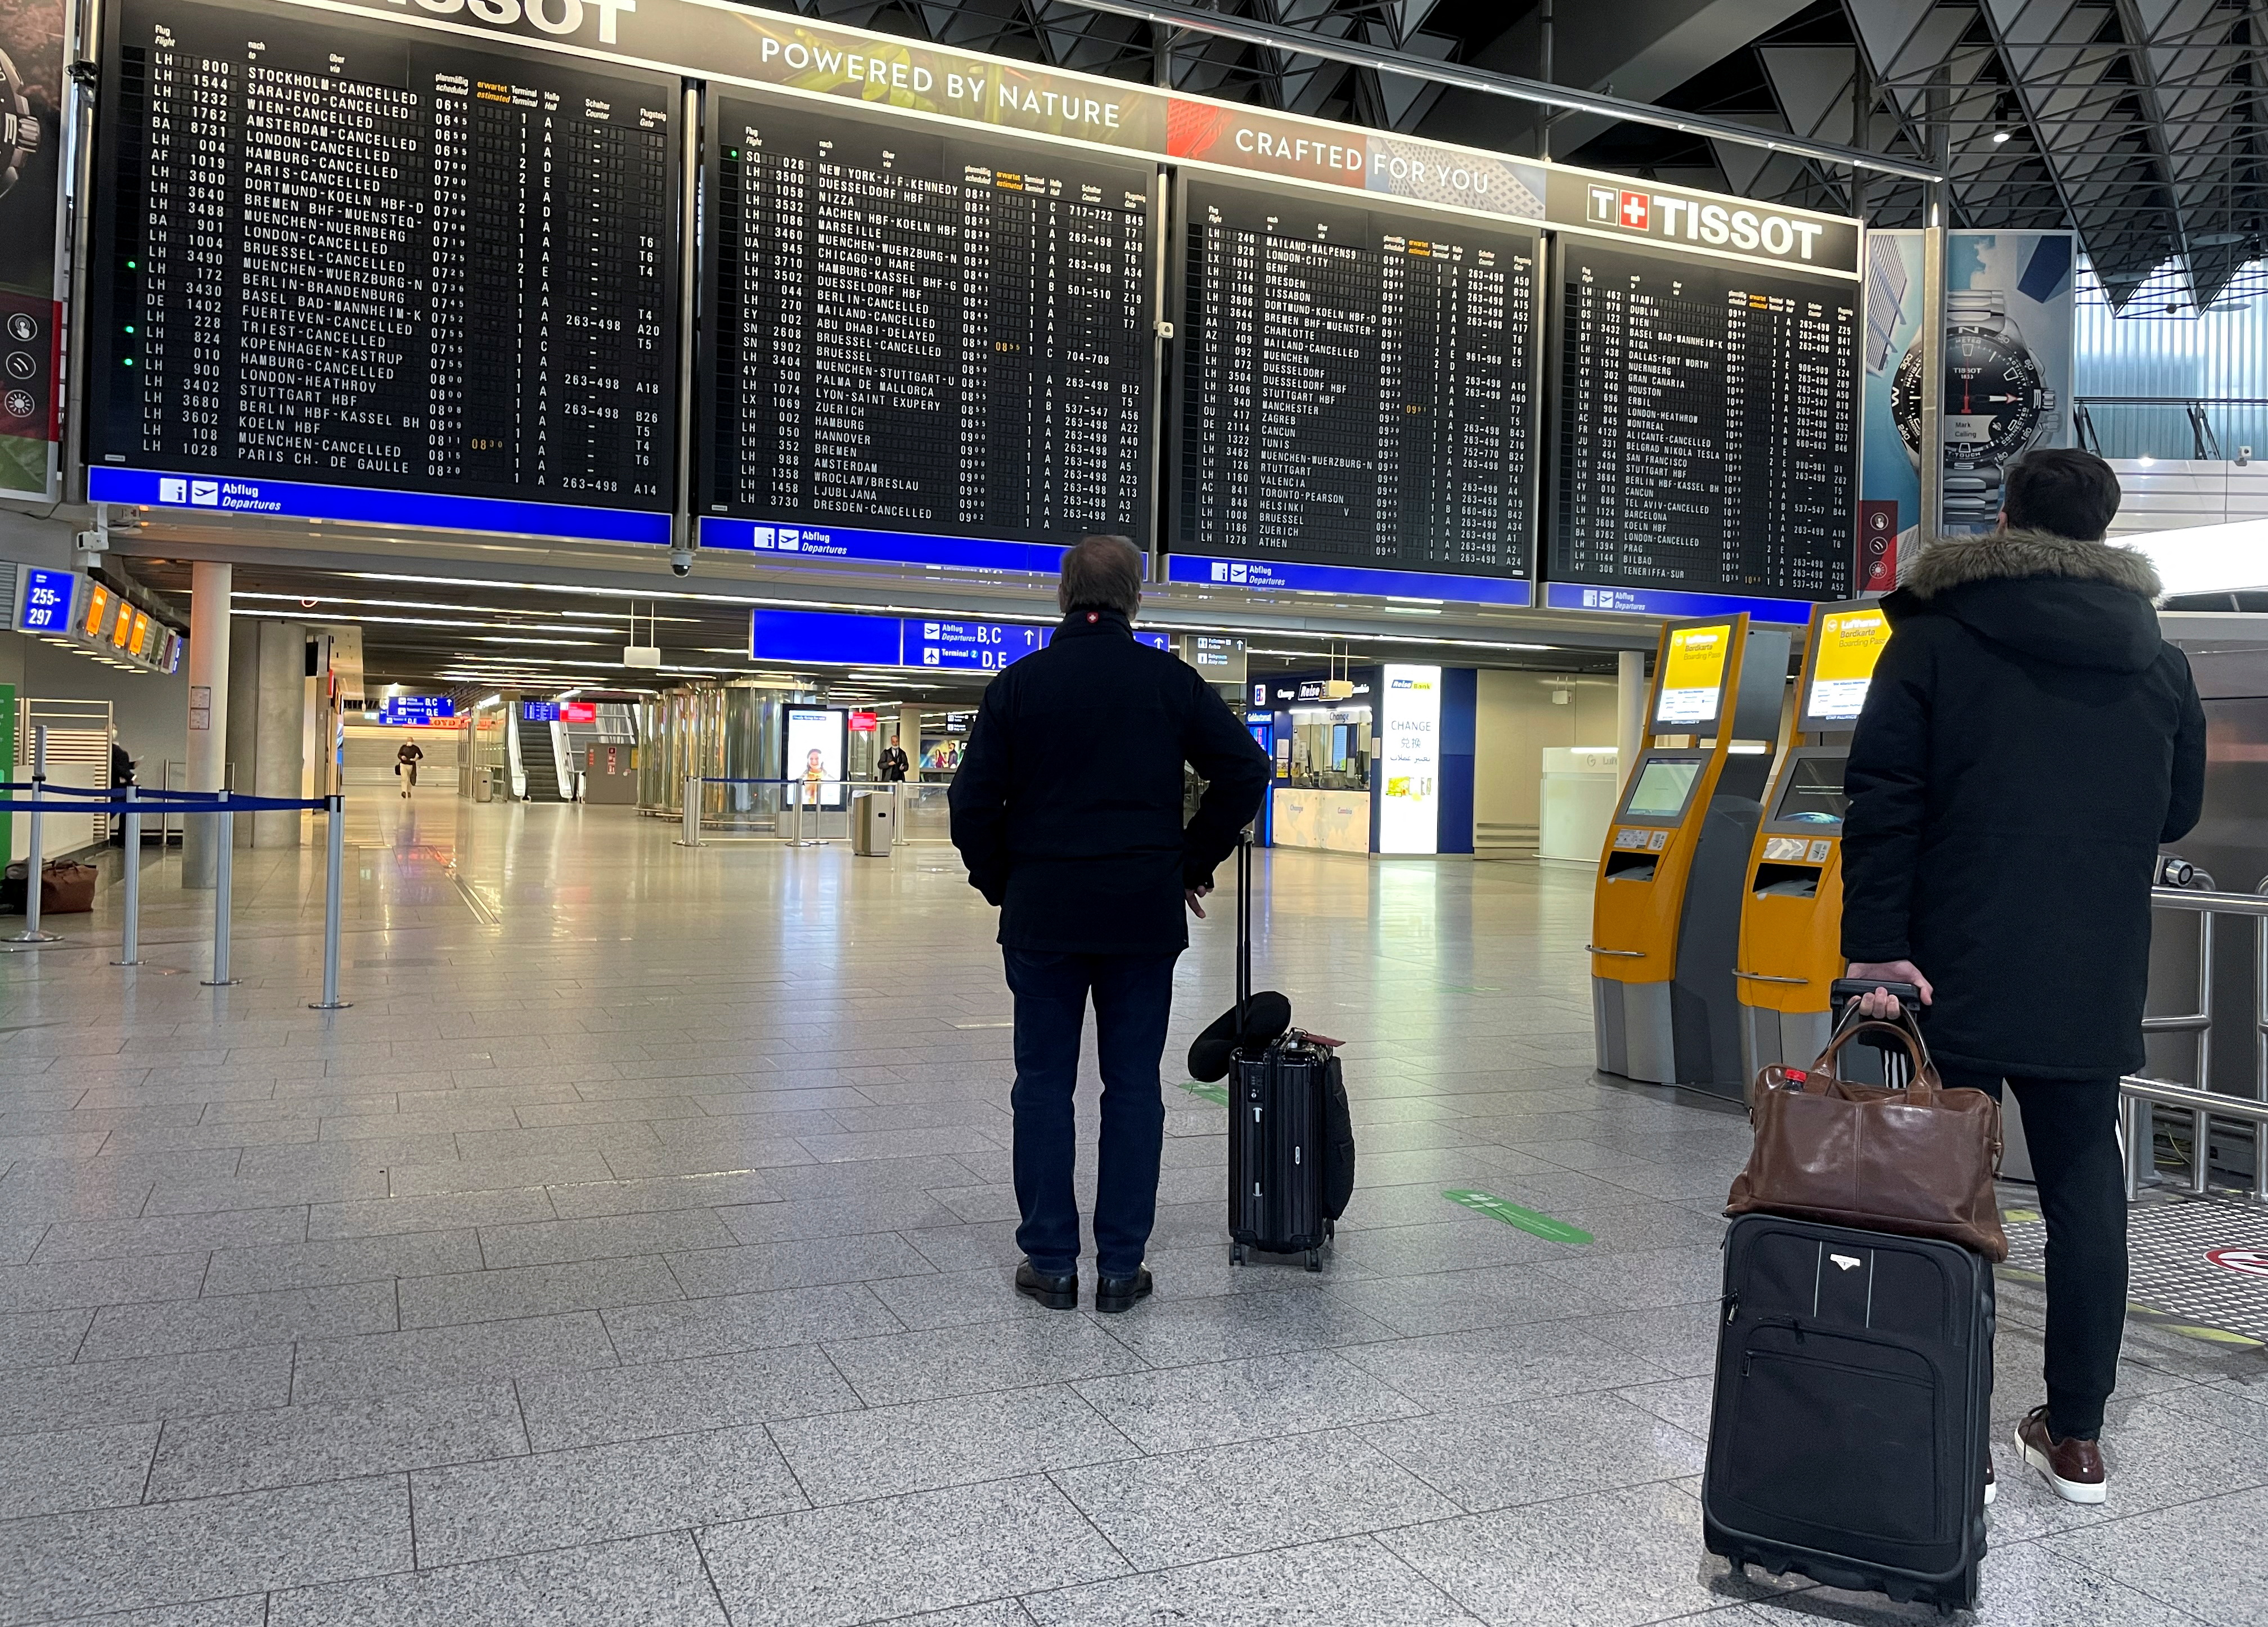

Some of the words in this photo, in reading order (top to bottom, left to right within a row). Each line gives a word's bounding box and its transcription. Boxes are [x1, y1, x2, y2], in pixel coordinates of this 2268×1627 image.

[155, 24, 170, 37] Flug
[248, 41, 265, 51] nach
[328, 53, 345, 64] über
[435, 72, 469, 87] planmäßig
[476, 81, 507, 93] erwartet
[510, 84, 537, 97] Terminal
[544, 91, 560, 101] Halle
[584, 98, 610, 110] Schalter
[640, 107, 667, 121] Flugsteig
[155, 51, 172, 66] LH
[202, 59, 228, 74] 800
[248, 66, 417, 105] STOCKHOLM-CANCELLED
[154, 35, 176, 47] Flight
[248, 51, 256, 60] to
[329, 64, 340, 73] via
[435, 83, 469, 96] scheduled
[476, 91, 511, 103] estimated
[511, 95, 538, 107] Terminal
[544, 101, 557, 111] Hall
[585, 108, 610, 120] Counter
[639, 117, 654, 128] Gate
[761, 36, 934, 94] POWERED
[946, 72, 988, 104] BY
[998, 83, 1121, 129] NATURE
[248, 82, 408, 119] SARAJEVO-CANCELLED
[246, 98, 372, 128] WIEN-CANCELLED
[152, 115, 170, 129] BA
[190, 121, 225, 137] 8731
[246, 129, 390, 162] LONDON-CANCELLED
[246, 114, 416, 151] AMSTERDAM-CANCELLED
[245, 145, 398, 179] HAMBURG-CANCELLED
[745, 150, 760, 163] SQ
[782, 156, 804, 170] 026
[818, 163, 840, 176] NEW
[1234, 127, 1363, 173] CRAFTED
[1373, 154, 1426, 185] FOR
[1436, 165, 1490, 195] YOU
[245, 161, 380, 192] PARIS-CANCELLED
[245, 177, 371, 206] DORTMUND-KOELN
[381, 197, 424, 213] HBF-D
[818, 191, 854, 206] NIZZA
[244, 209, 405, 242] MUENCHEN-NUERNBERG
[817, 219, 881, 239] MARSEILLE
[1652, 195, 1822, 260] TISSOT
[244, 241, 404, 273] BRUESSEL-CANCELLED
[817, 247, 881, 266] CHICAGO-O
[888, 258, 915, 271] HARE
[1266, 249, 1328, 267] LONDON-CITY
[1265, 262, 1288, 274] GENF
[148, 261, 165, 274] LH
[197, 267, 222, 281] 172
[242, 272, 404, 304] BERLIN-BRANDENBURG
[1265, 274, 1305, 289] DRESDEN
[817, 289, 928, 314] BERLIN-CANCELLED
[1265, 286, 1311, 302] LISSABON
[817, 303, 935, 329] MAILAND-CANCELLED
[1630, 304, 1658, 317] DUBLIN
[242, 304, 412, 335] FUERTEVEN-CANCELLED
[744, 307, 757, 319] EY
[781, 312, 801, 325] 002
[816, 317, 838, 330] ABU
[845, 321, 935, 343] DHABI-DELAYED
[241, 320, 385, 348] TRIEST-CANCELLED
[1264, 324, 1315, 340] CHARLOTTE
[241, 336, 402, 365] KOPENHAGEN-KASTRUP
[1628, 339, 1648, 350] RIGA
[816, 345, 871, 362] BRUESSEL
[1900, 353, 1914, 370] 300
[241, 367, 376, 393] LONDON-HEATHROV
[240, 383, 321, 403] STUTTGART
[331, 393, 357, 406] HBF
[1627, 384, 1661, 397] HOUSTON
[2033, 389, 2041, 409] E
[815, 401, 864, 416] ZUERICH
[1262, 399, 1318, 415] MANCHESTER
[1261, 412, 1295, 425] ZAGREB
[2001, 407, 2027, 445] CONNECTED
[238, 431, 400, 457] MUENCHEN-CANCELLED
[814, 429, 870, 445] HANNOVER
[1262, 437, 1289, 449] TUNIS
[814, 443, 857, 457] BREMEN
[813, 457, 877, 473] AMSTERDAM
[1626, 452, 1640, 462] SAN
[1645, 454, 1687, 468] FRANCISCO
[814, 471, 919, 491] WROCLAW/BRESLAU
[1260, 475, 1306, 488] VALENCIA
[222, 483, 259, 497] Abflug
[1260, 487, 1344, 504] TORONTO-PEARSON
[222, 496, 281, 511] Departures
[813, 498, 932, 519] DRESDEN-CANCELLED
[1624, 509, 1667, 521] BARCELONA
[802, 531, 830, 543] Abflug
[1258, 537, 1287, 548] ATHEN
[802, 542, 847, 555] Departures
[1623, 543, 1642, 553] PRAG
[1622, 554, 1652, 565] BILBAO
[1249, 565, 1272, 576] Abflug
[1249, 575, 1286, 586] Departures
[32, 587, 61, 605] 255-
[1615, 592, 1634, 601] Abflug
[1614, 601, 1645, 610] Departures
[29, 608, 52, 626] 297
[1841, 619, 1881, 630] Lufthansa
[941, 633, 976, 642] Departures
[942, 624, 963, 633] Abflug
[976, 626, 1002, 645] B,C
[1840, 629, 1875, 639] Bordkarte
[1839, 639, 1869, 648] Boarding
[942, 648, 969, 658] Terminal
[982, 650, 1007, 670] D,E
[1300, 684, 1320, 697] Reise
[1330, 712, 1349, 723] Change
[1391, 721, 1432, 731] CHANGE
